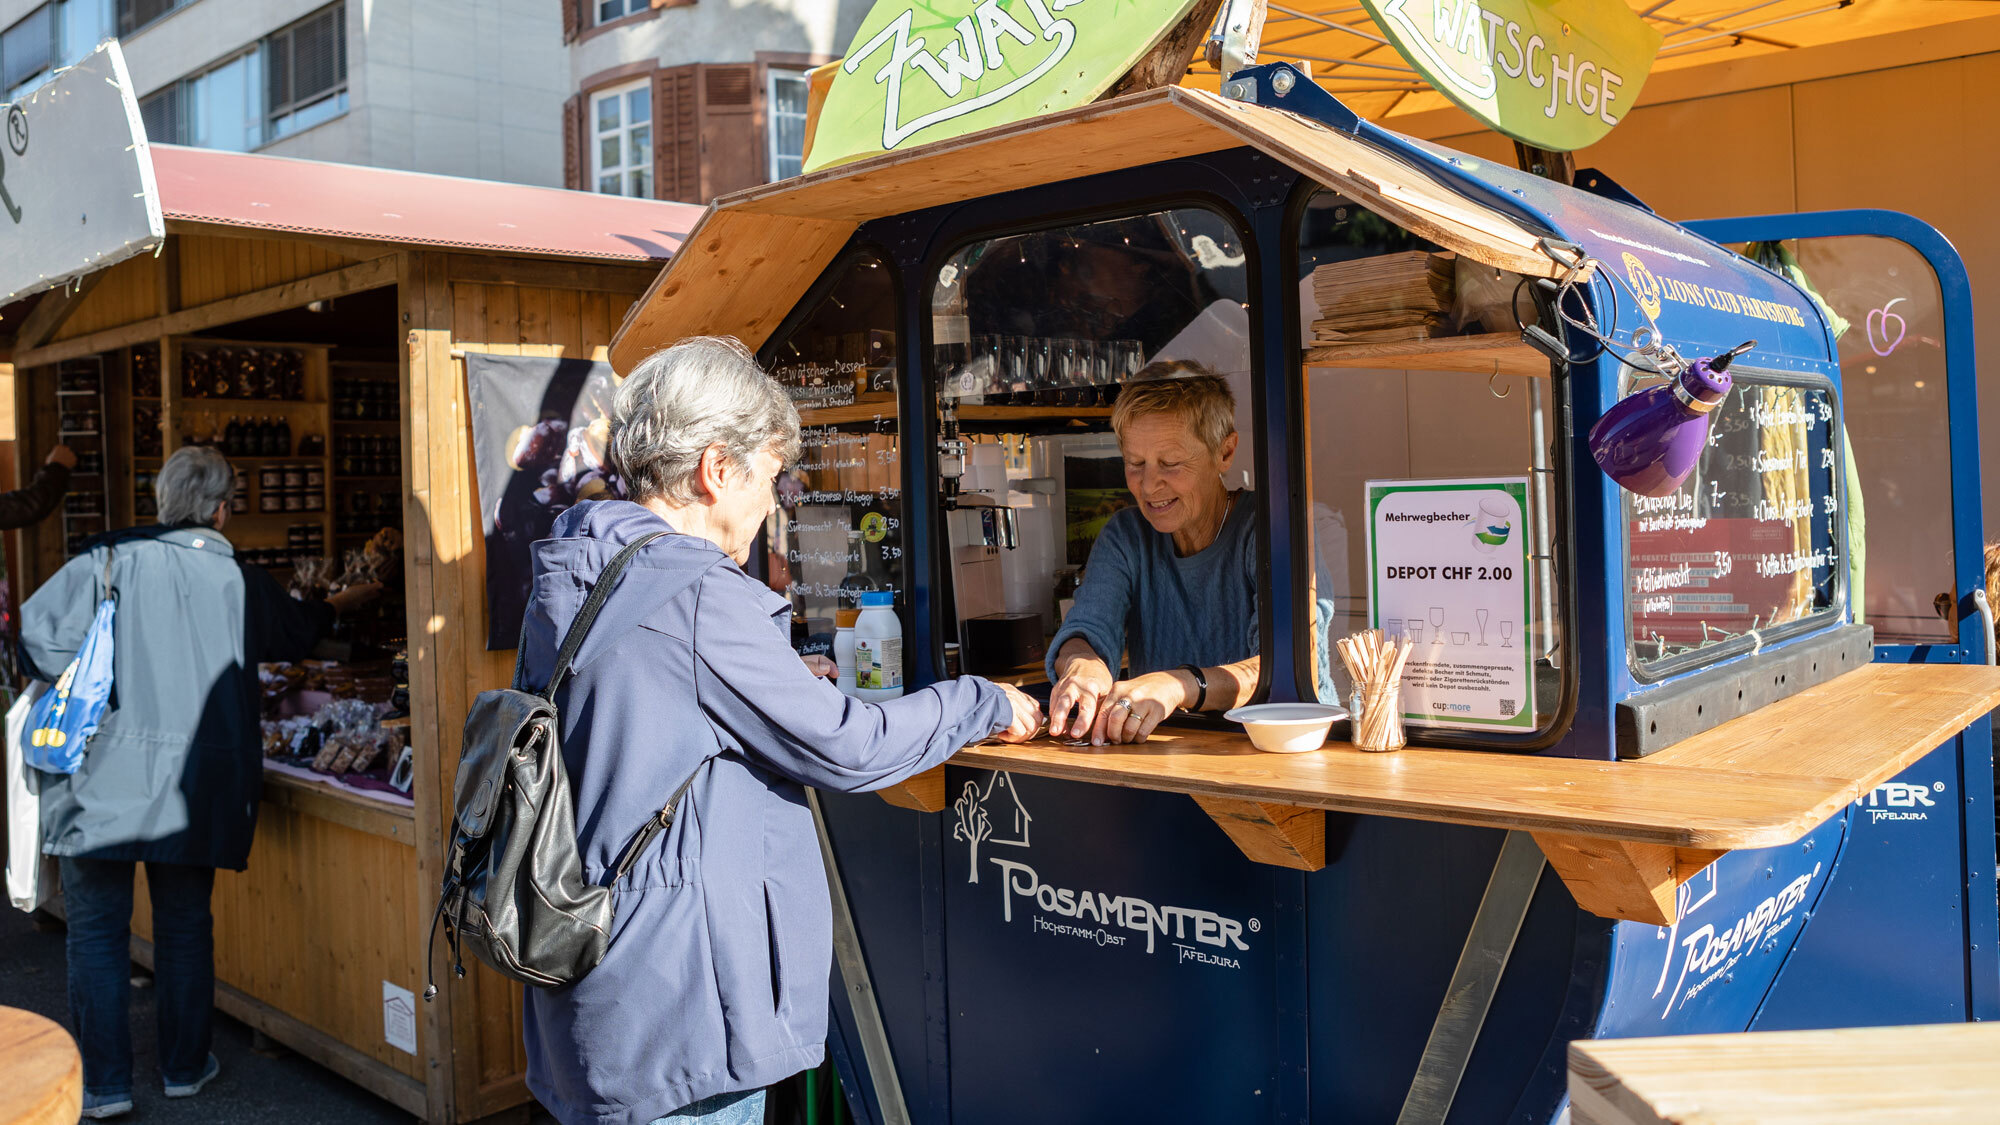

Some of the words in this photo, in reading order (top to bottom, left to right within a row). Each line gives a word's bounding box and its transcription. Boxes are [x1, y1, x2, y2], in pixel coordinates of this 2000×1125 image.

[1656, 275, 1705, 308] LIONS
[1703, 286, 1741, 315] CLUB
[880, 516, 899, 531] 2.50
[1385, 511, 1470, 524] Mehrwegbecher
[882, 545, 902, 560] 3.50
[1387, 566, 1437, 580] DEPOT
[1442, 566, 1473, 580] CHF
[1477, 566, 1513, 580] 2.00
[1466, 670, 1492, 678] Schmutz,
[1865, 809, 1928, 825] TAFELJURA
[1172, 942, 1241, 970] TAFELJURA
